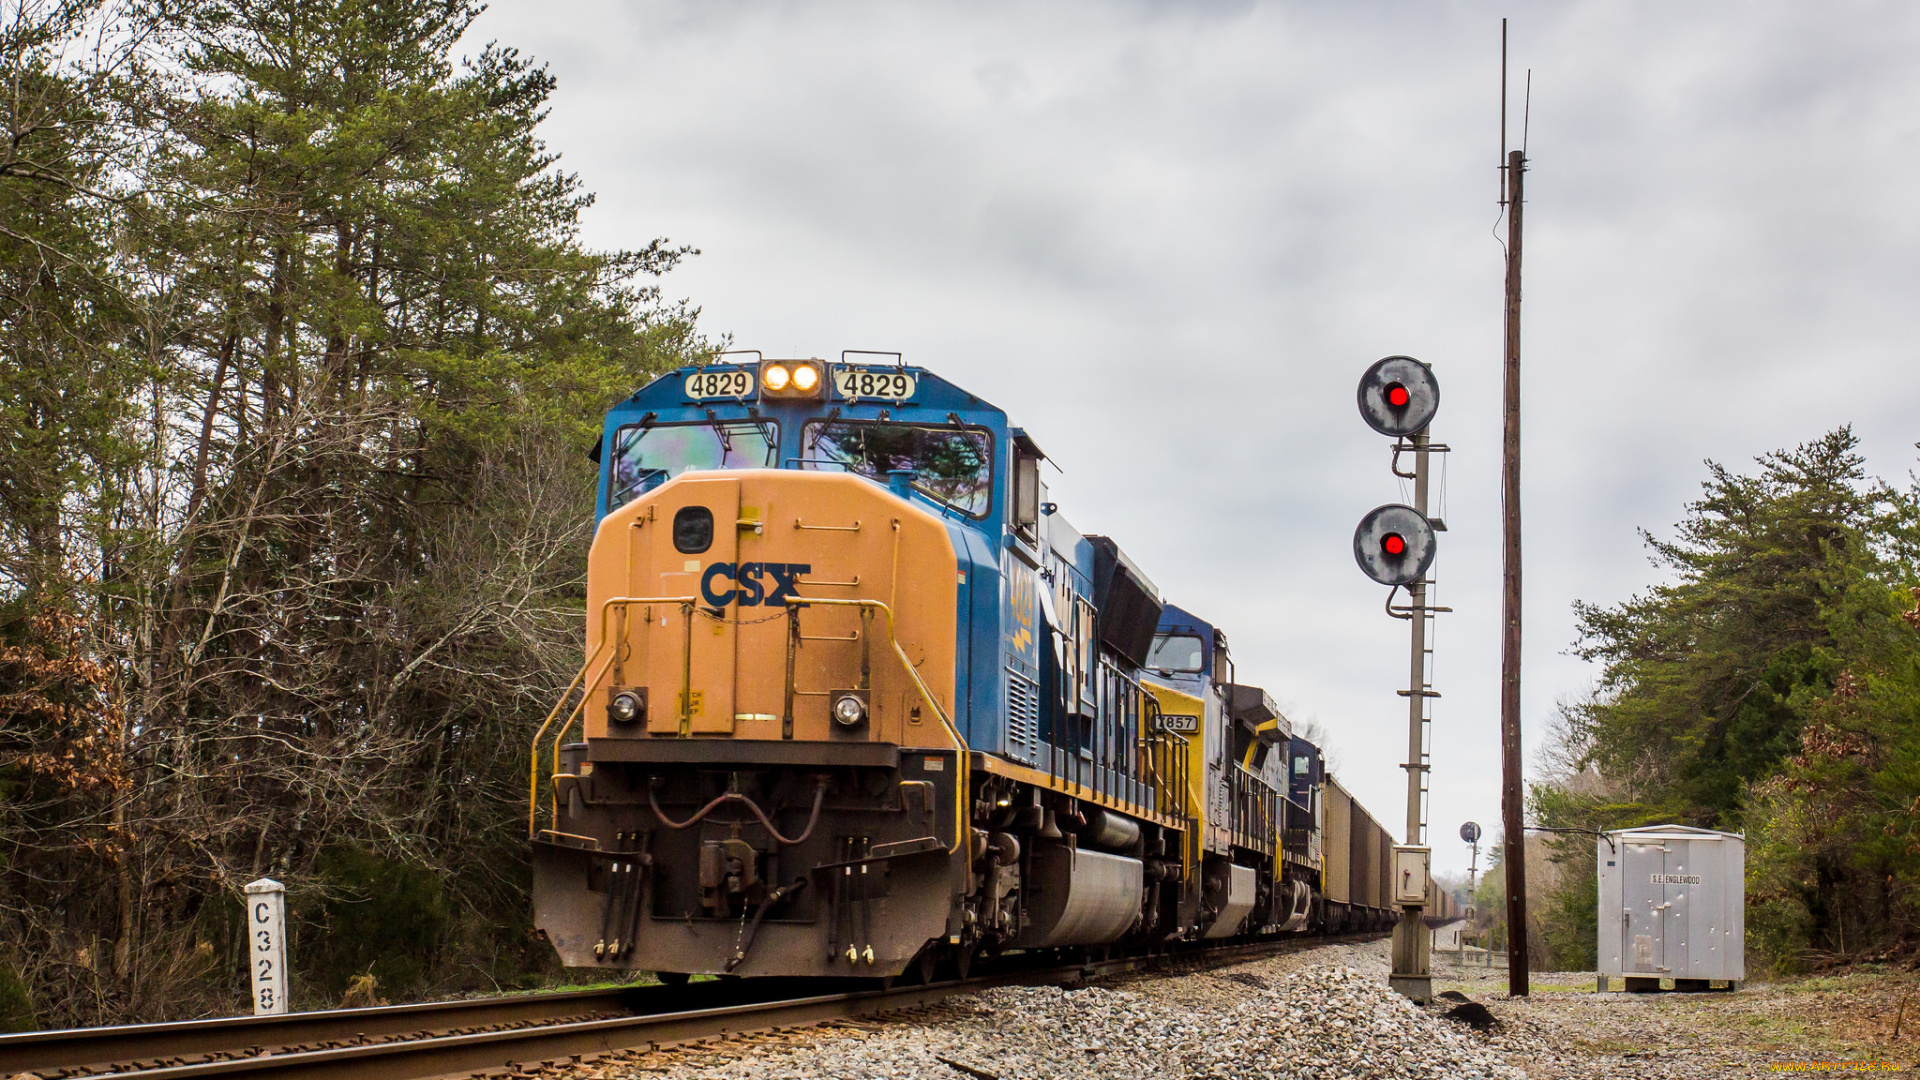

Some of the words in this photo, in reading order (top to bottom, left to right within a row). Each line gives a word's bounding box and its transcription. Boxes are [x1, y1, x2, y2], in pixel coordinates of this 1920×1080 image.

[691, 373, 747, 397] 4829
[843, 373, 908, 397] 4829
[701, 562, 811, 608] CSX
[1665, 875, 1700, 885] ENGLEWOOD
